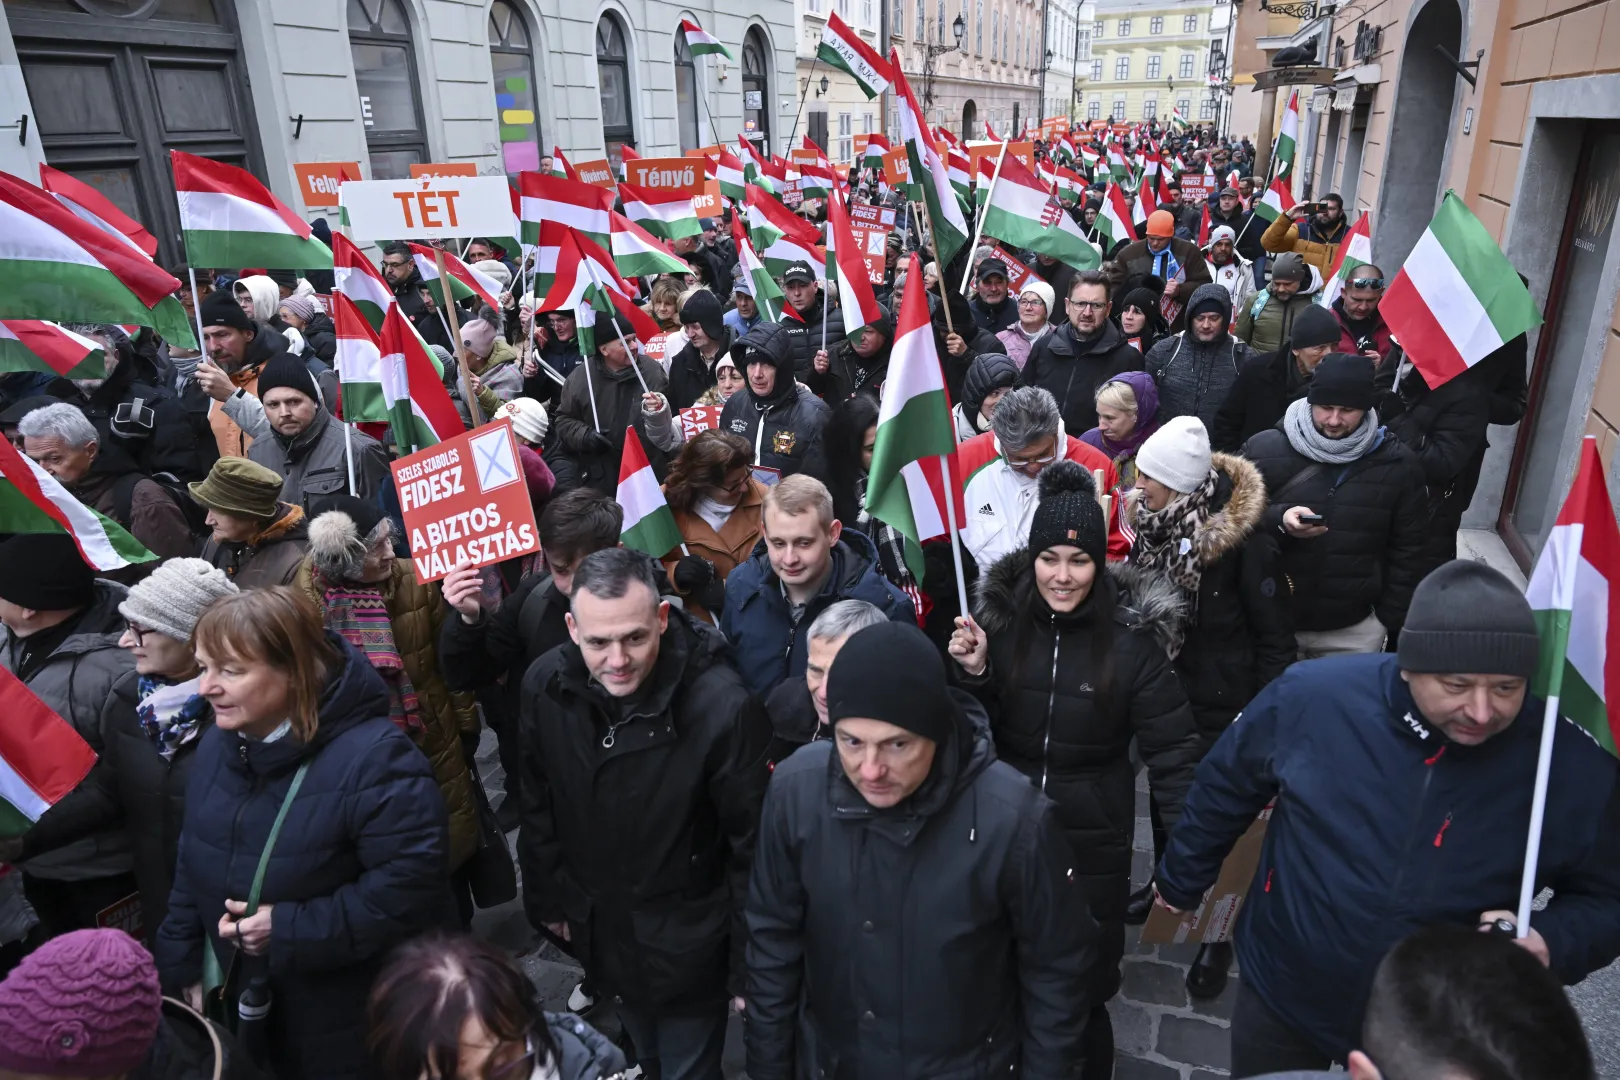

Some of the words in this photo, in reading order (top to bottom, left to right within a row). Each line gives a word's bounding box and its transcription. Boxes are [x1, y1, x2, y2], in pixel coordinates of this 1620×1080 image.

[307, 174, 339, 194] Felp
[580, 169, 610, 184] Újváros
[637, 166, 695, 188] Tényő
[393, 181, 460, 228] TÉT
[851, 209, 877, 220] FIDESZ
[785, 266, 807, 275] adidas
[645, 342, 667, 353] IDES
[397, 462, 423, 484] SZELES
[422, 447, 460, 474] SZABOLCS
[400, 464, 465, 513] FIDESZ
[412, 527, 428, 553] A
[425, 502, 501, 547] BIZTOS
[414, 521, 535, 580] VÁLASZTÁS
